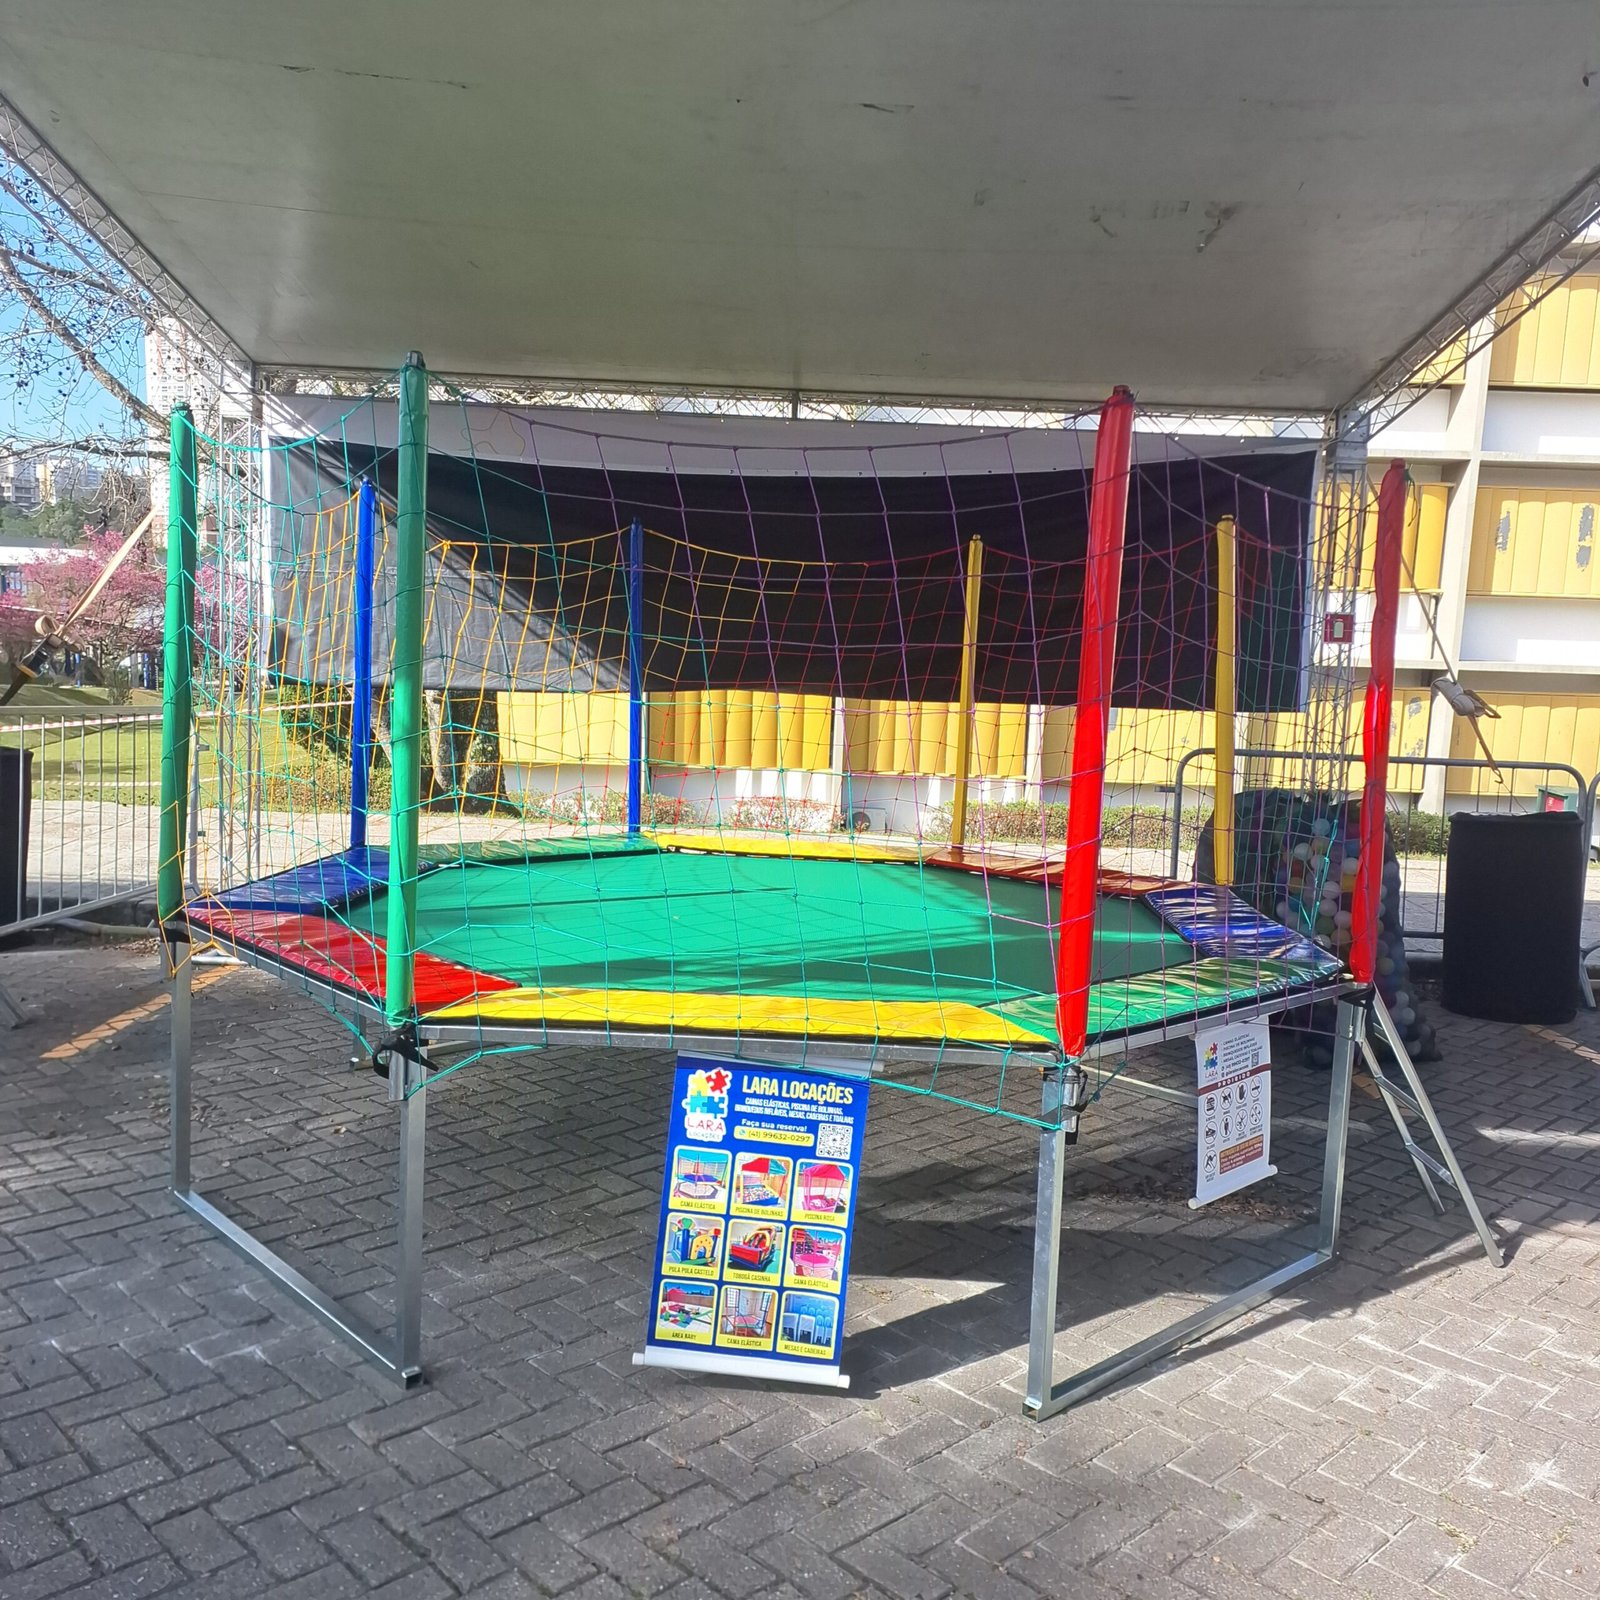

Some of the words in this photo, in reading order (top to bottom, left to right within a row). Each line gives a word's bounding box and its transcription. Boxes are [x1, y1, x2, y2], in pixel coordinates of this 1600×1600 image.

[1205, 1070, 1218, 1078] LARA
[1218, 1072, 1250, 1088] PROIBIDO
[742, 1075, 778, 1096] LARA
[782, 1080, 854, 1105] LOCAÇÕES
[687, 1116, 724, 1132] LARA
[741, 1119, 760, 1128] Faça
[777, 1123, 807, 1132] reserva!
[748, 1130, 761, 1139] (41)
[763, 1131, 811, 1142] 99632-0297
[680, 1200, 693, 1209] CAMA
[694, 1200, 716, 1210] ELÁSTICA
[735, 1206, 753, 1215] PISCINA
[761, 1209, 784, 1218] BOLINHAS
[694, 1268, 714, 1276] CASTELO
[733, 1272, 749, 1280] TOBOGÃ
[751, 1274, 771, 1282] CASINHA
[794, 1278, 806, 1286] CAMA
[808, 1278, 829, 1288] ELÁSTICA
[740, 1338, 762, 1347] ELÁSTICA
[784, 1344, 799, 1352] MESAS
[804, 1346, 826, 1356] CADEIRAS
